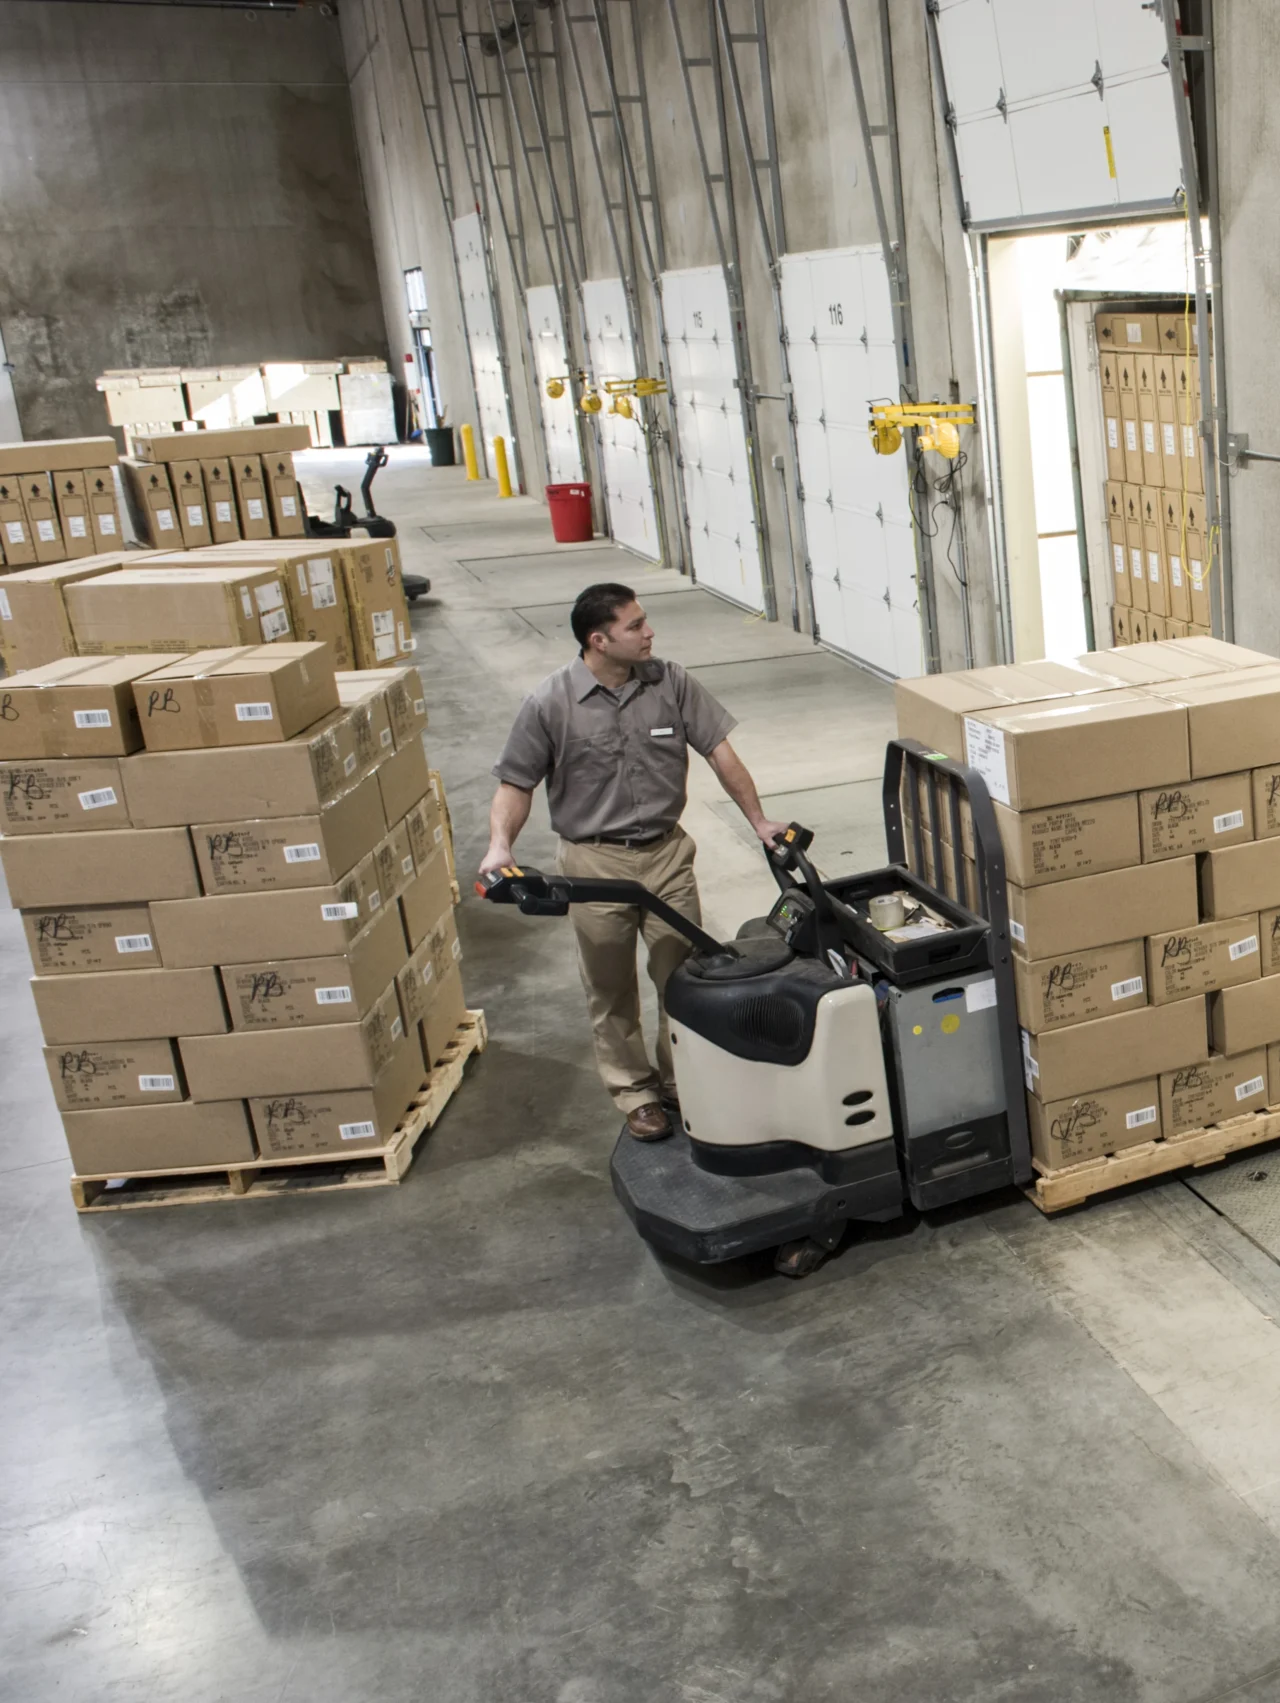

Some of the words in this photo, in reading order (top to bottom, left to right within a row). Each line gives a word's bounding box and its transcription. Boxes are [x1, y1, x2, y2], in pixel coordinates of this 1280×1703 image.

[692, 310, 704, 329] 115
[828, 302, 844, 326] 116
[0, 693, 20, 722] B
[148, 687, 181, 718] RB
[1045, 962, 1075, 999] RB
